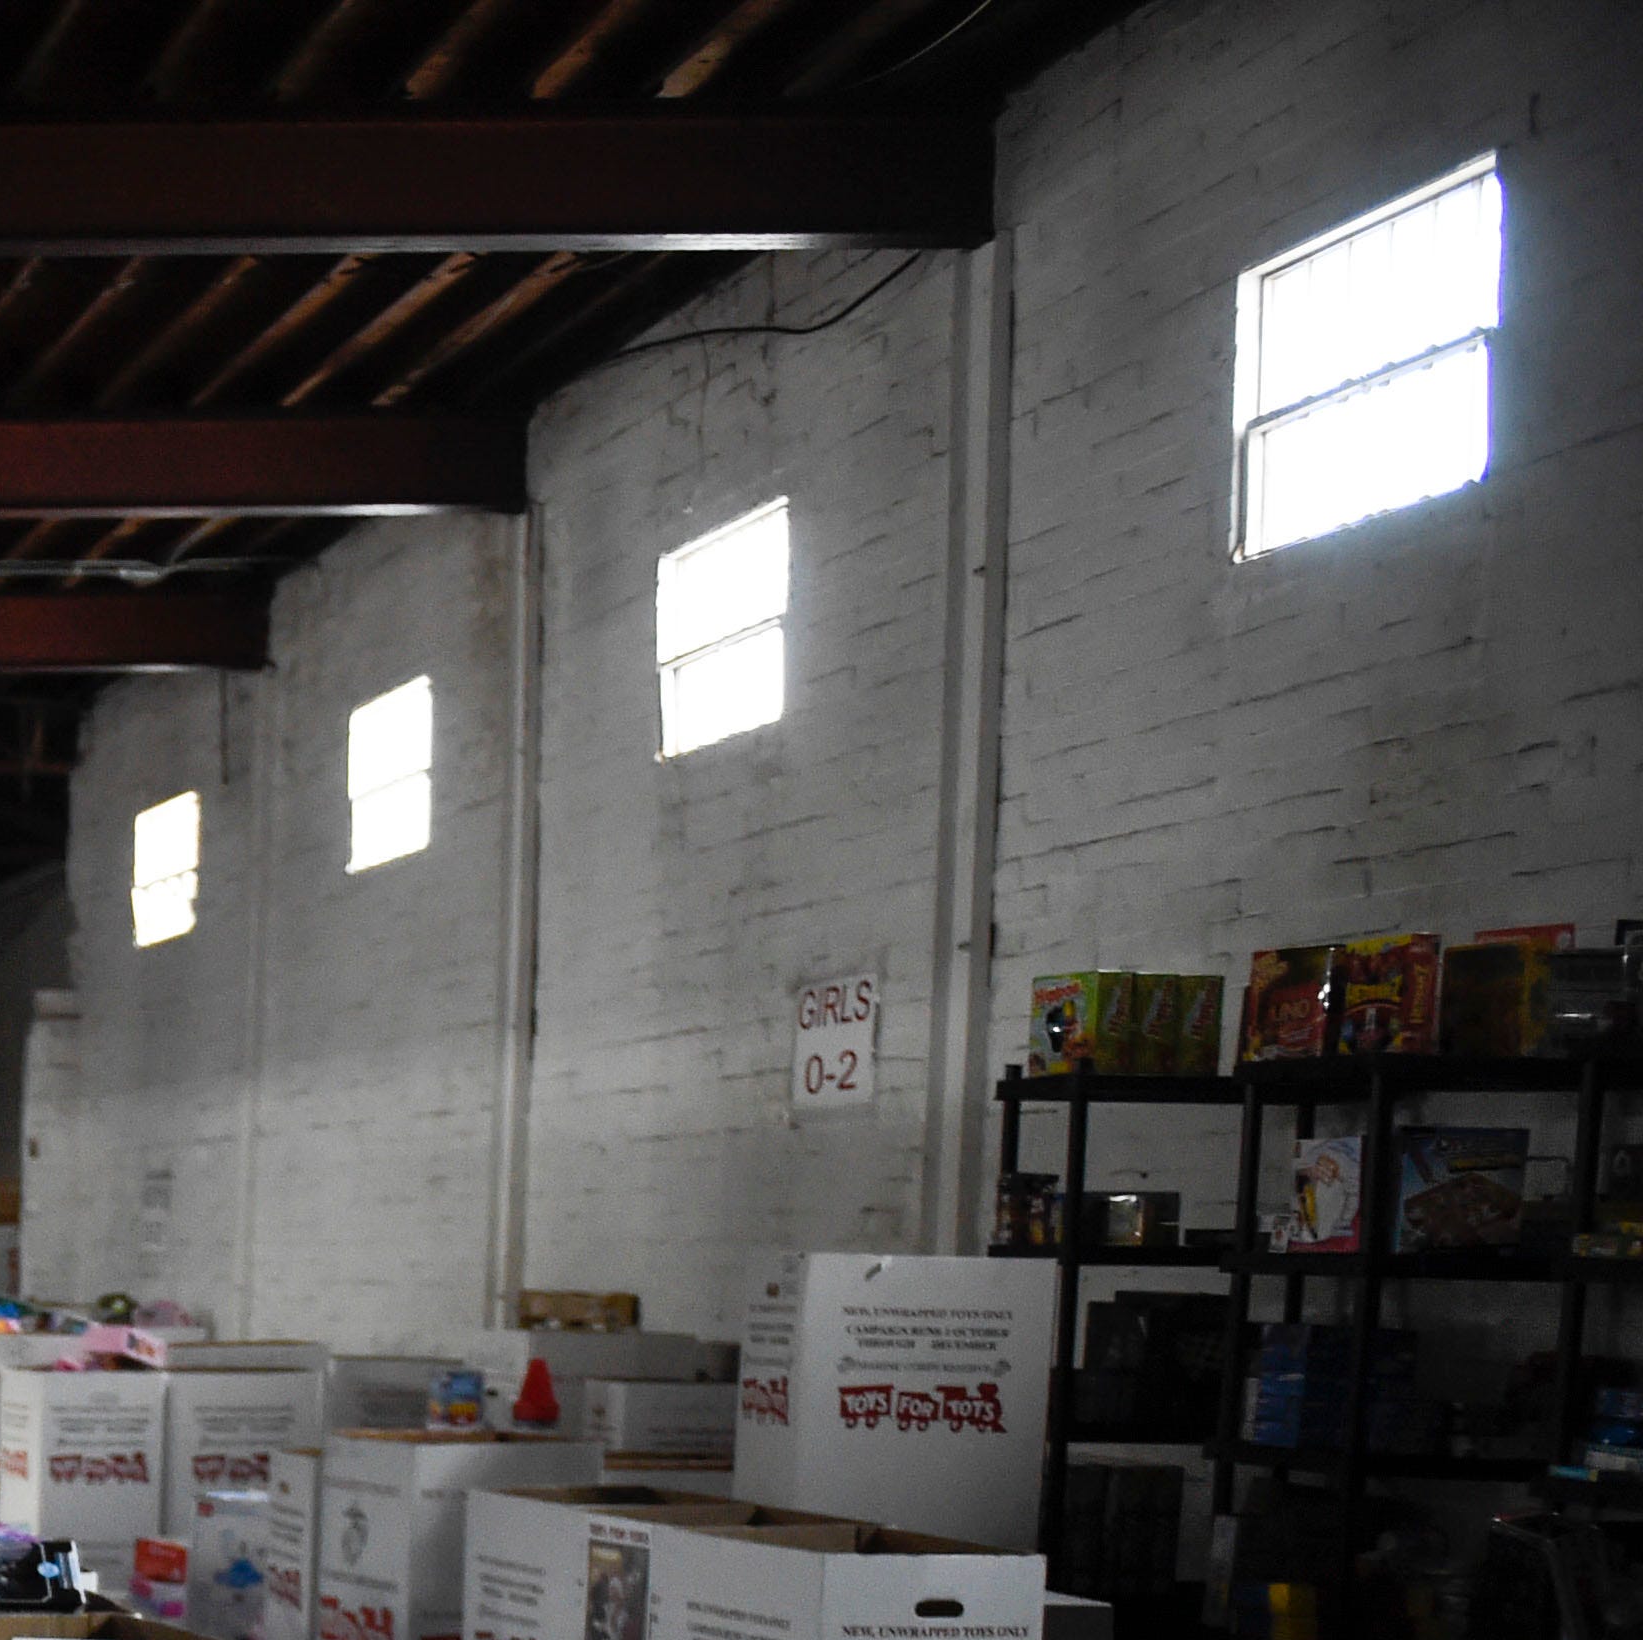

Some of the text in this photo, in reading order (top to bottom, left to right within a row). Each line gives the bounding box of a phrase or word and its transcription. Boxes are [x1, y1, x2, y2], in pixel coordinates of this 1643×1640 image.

[799, 980, 872, 1030] GIRLS
[805, 1049, 857, 1095] 0-2
[845, 1392, 996, 1423] TOYS FOR TOTS
[842, 1626, 1030, 1639] NEW, UNWRAPPED TOYS ONLY
